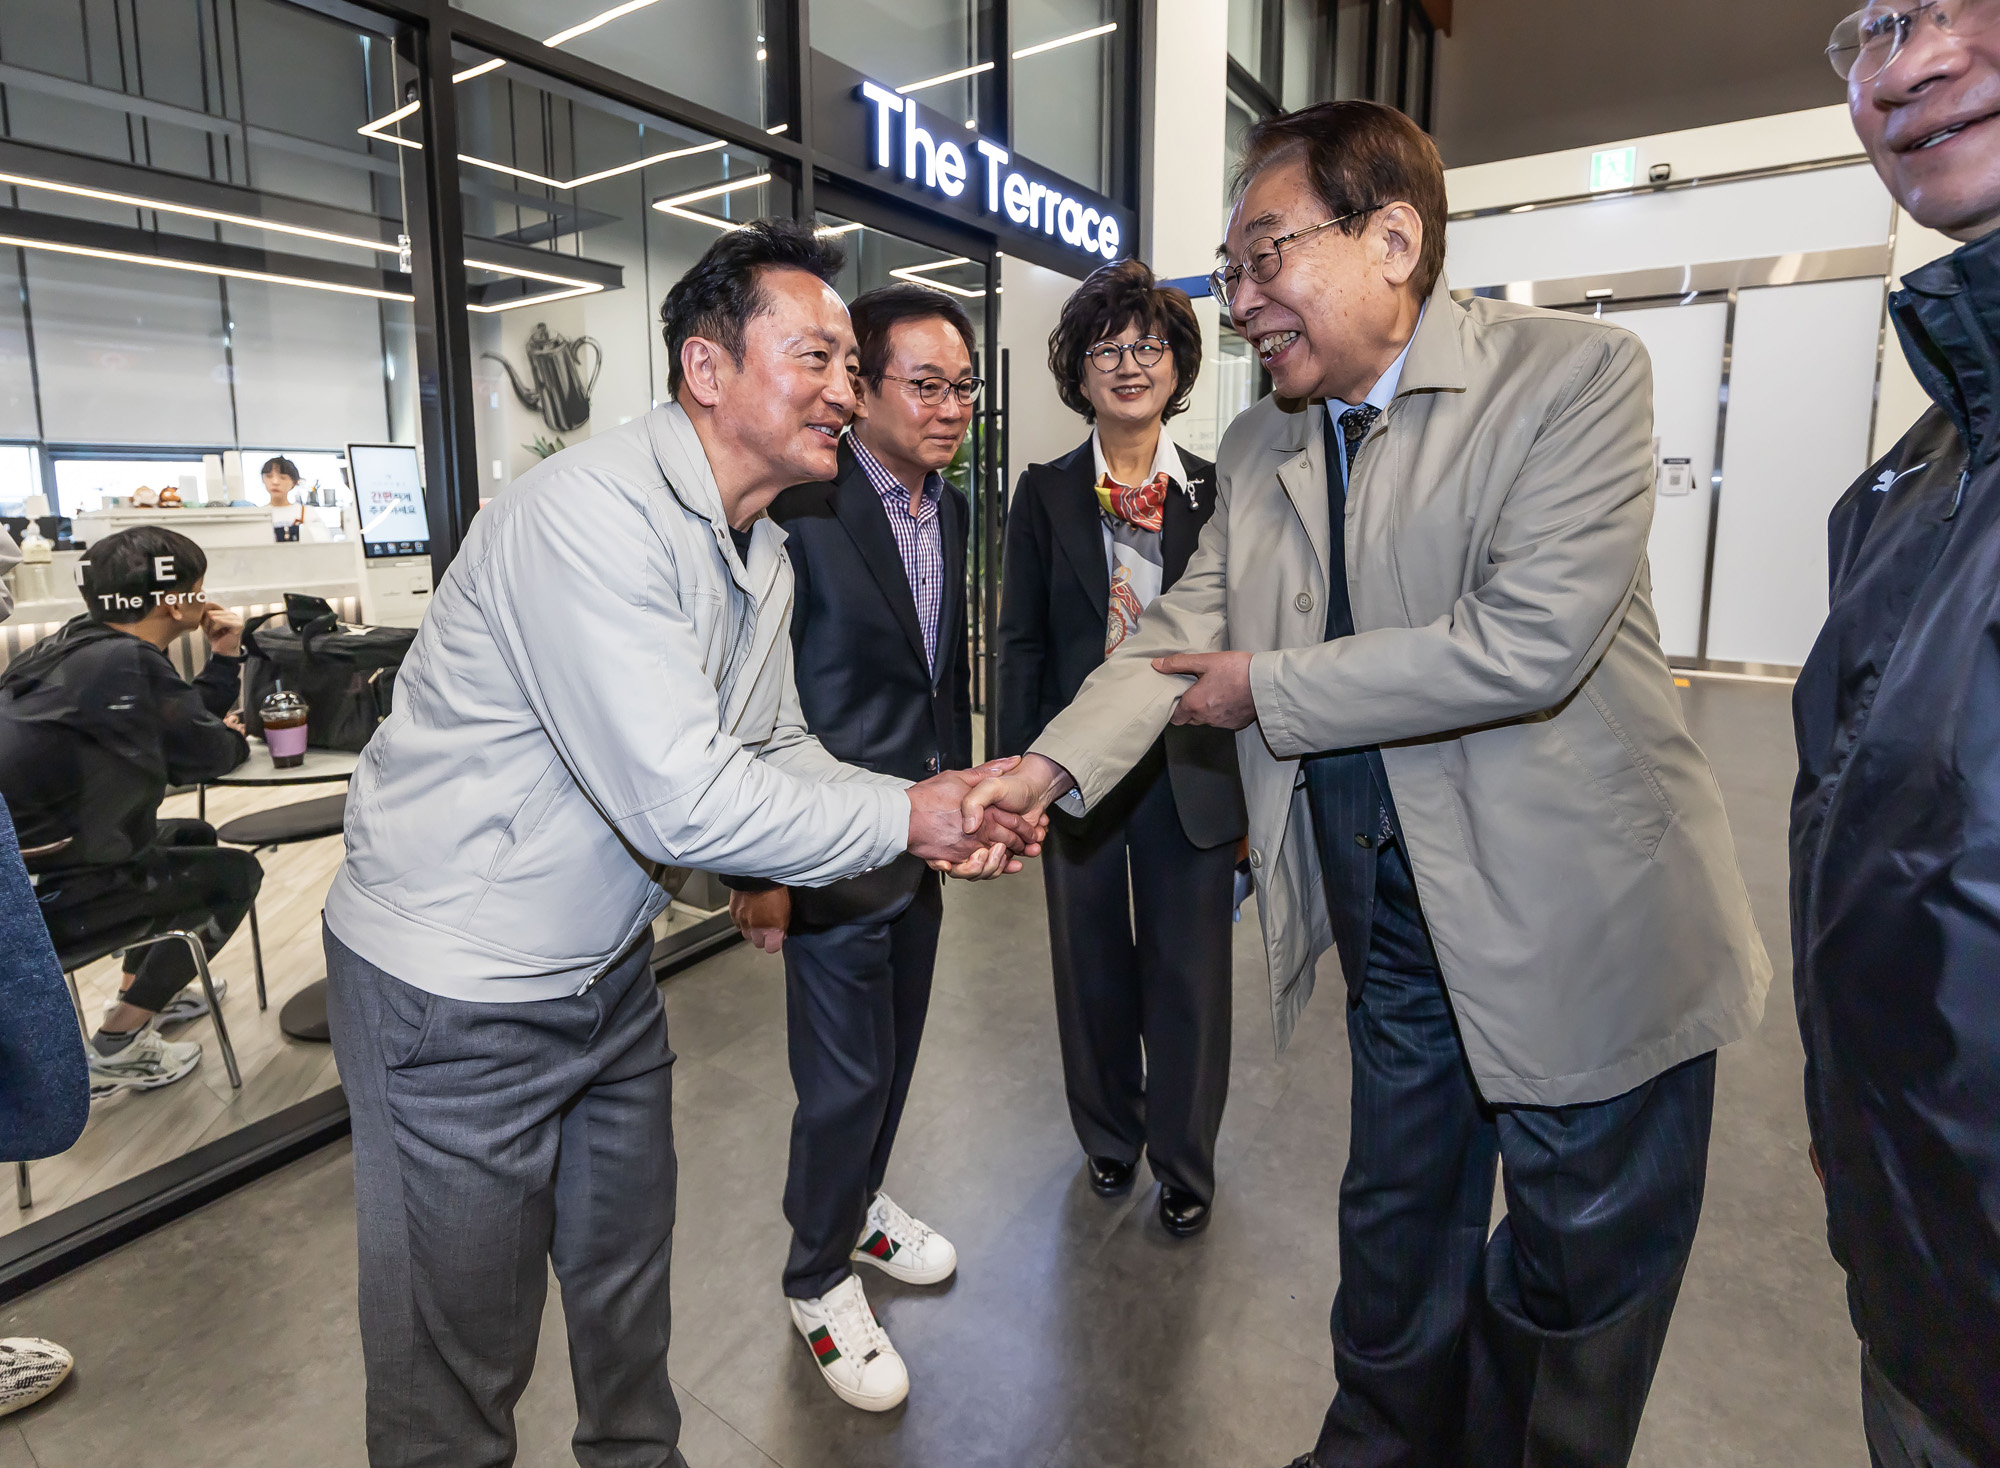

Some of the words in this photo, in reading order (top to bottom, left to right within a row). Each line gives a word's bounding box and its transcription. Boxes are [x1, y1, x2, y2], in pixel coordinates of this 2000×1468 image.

[863, 80, 967, 197] The
[977, 139, 1120, 260] Terrace
[98, 593, 144, 611] The
